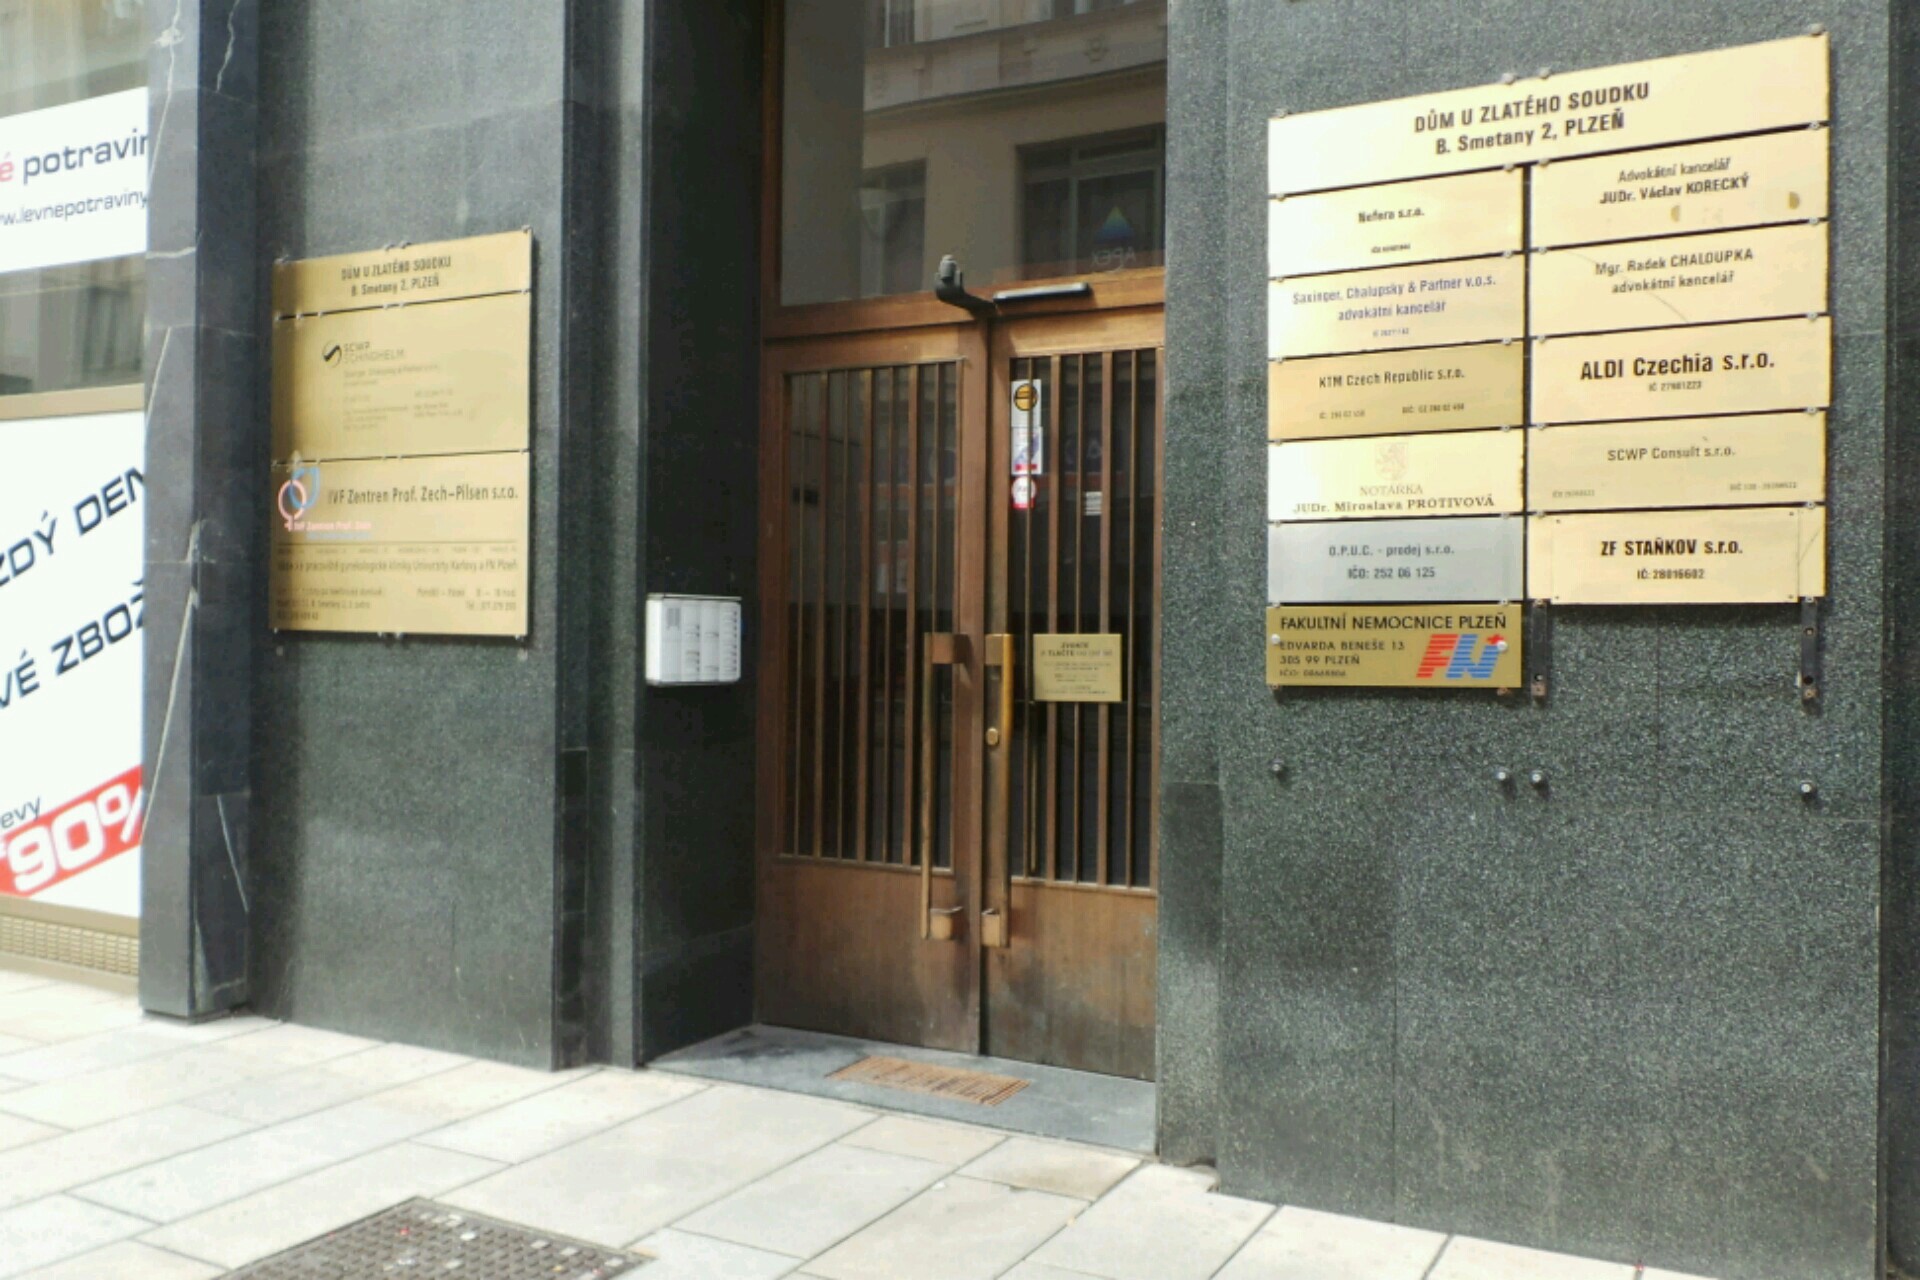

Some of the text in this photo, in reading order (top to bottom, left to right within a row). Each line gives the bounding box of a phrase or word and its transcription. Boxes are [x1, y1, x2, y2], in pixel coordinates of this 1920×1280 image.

[1414, 81, 1650, 133] DŮM U ZLATÉHO SOUDKU
[1436, 107, 1625, 155] B. Smetany 2, PLZEŇ
[1618, 156, 1731, 183] Advokátní kancelář
[1599, 190, 1636, 205] JUDr.
[1639, 185, 1682, 200] Václav
[363, 265, 370, 278] U
[413, 255, 451, 272] SOUDKU
[1595, 247, 1753, 277] Mgr. Radek CHALOUPKA
[361, 282, 398, 296] Smetany
[1408, 282, 1416, 293] &
[1420, 277, 1462, 293] Partner
[1612, 270, 1735, 293] advokátní kancelář
[1580, 352, 1775, 380] ALDI Czechia s.r.o.
[1319, 375, 1342, 389] KTM
[1346, 372, 1381, 386] Czech
[1384, 369, 1433, 384] Republic
[1607, 445, 1736, 461] SCWP Consult s.r.o.
[347, 488, 388, 504] Zentren
[392, 485, 418, 502] Prof.
[1293, 493, 1495, 513] JUDr. Miroslava PROTIVOVÁ
[1386, 543, 1422, 558] prodej
[1425, 544, 1455, 556] s.r.o.
[1600, 537, 1743, 556] ZF STAŇKOV s.r.o.
[1374, 566, 1393, 579] 252
[1416, 566, 1436, 579] 125
[1281, 611, 1507, 630] FAKULTNÍ NEMOCNICE PLZEŇ
[1280, 638, 1405, 651] EDVARDA BENEŠE 13
[1280, 653, 1360, 665] 305 99 PLZEŇ
